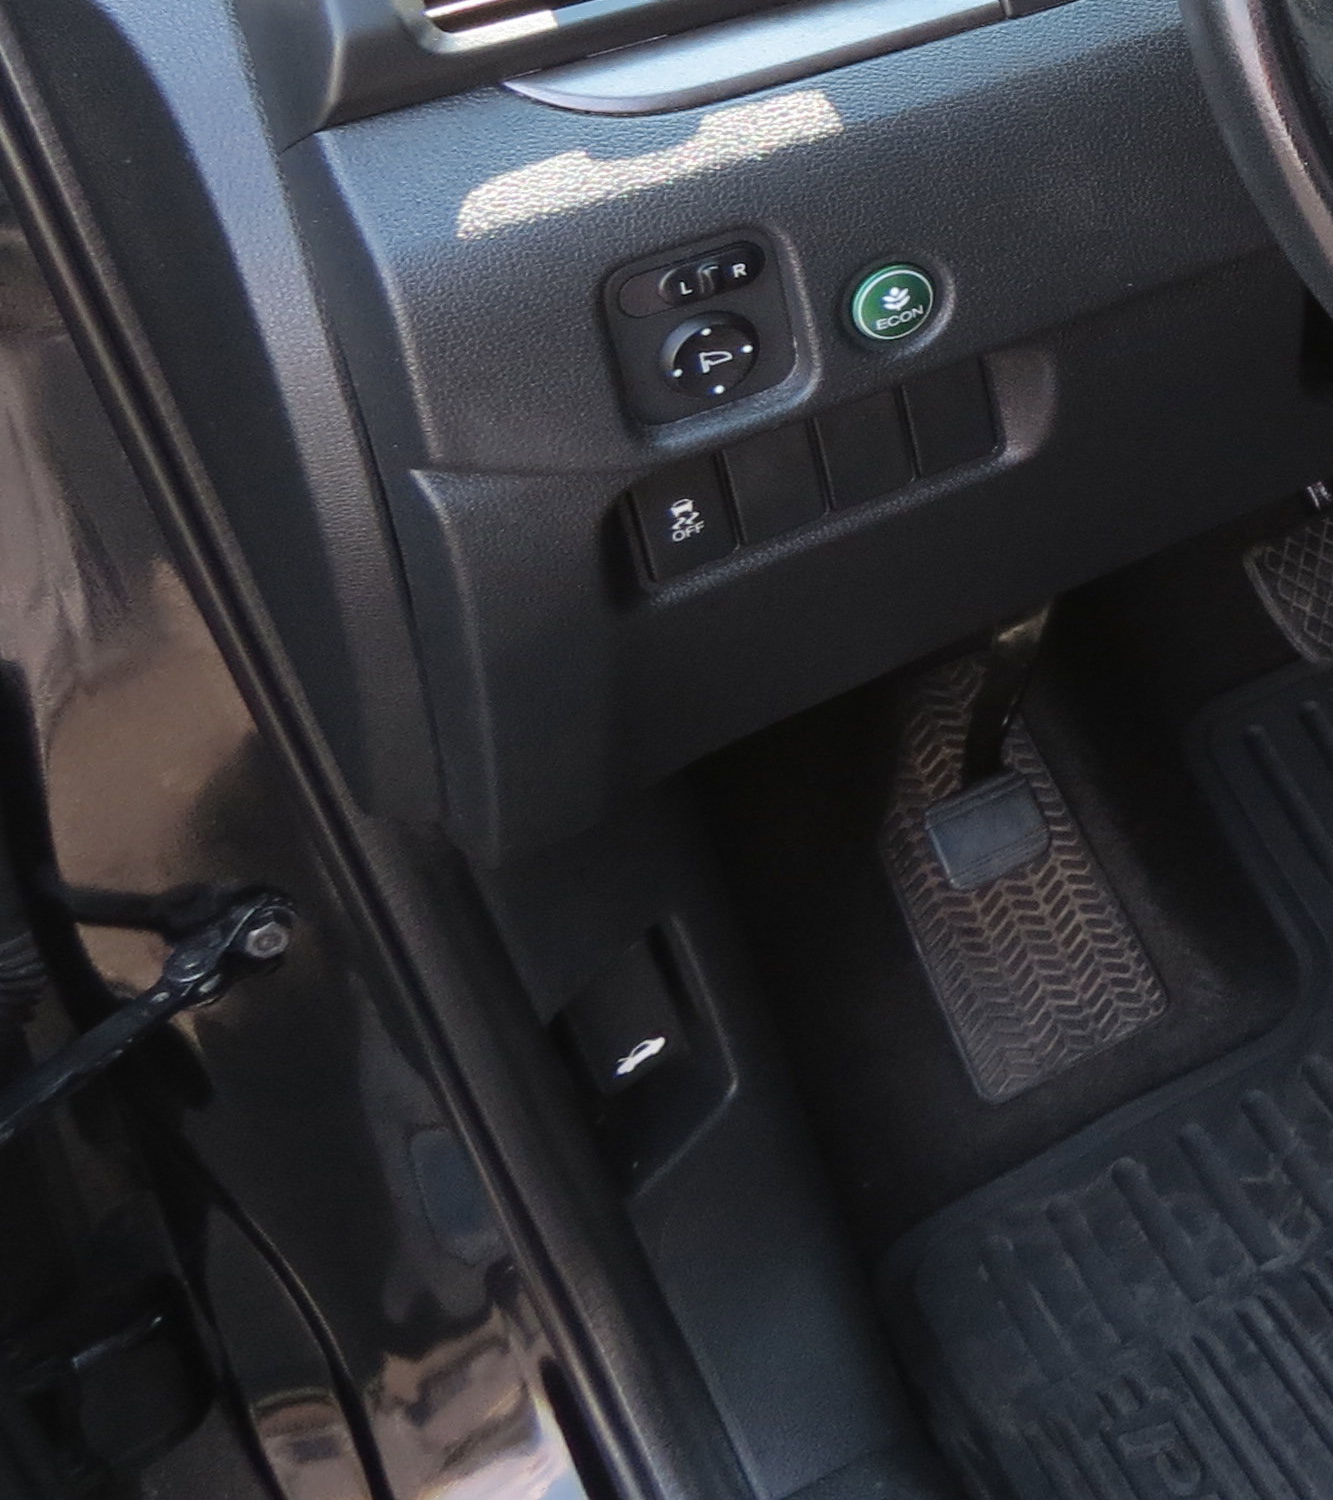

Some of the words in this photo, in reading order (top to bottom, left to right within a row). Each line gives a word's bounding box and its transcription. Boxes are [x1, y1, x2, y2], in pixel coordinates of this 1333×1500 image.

[680, 281, 694, 296] L
[732, 263, 748, 279] R
[876, 304, 925, 332] ECON
[671, 519, 705, 542] OFF
